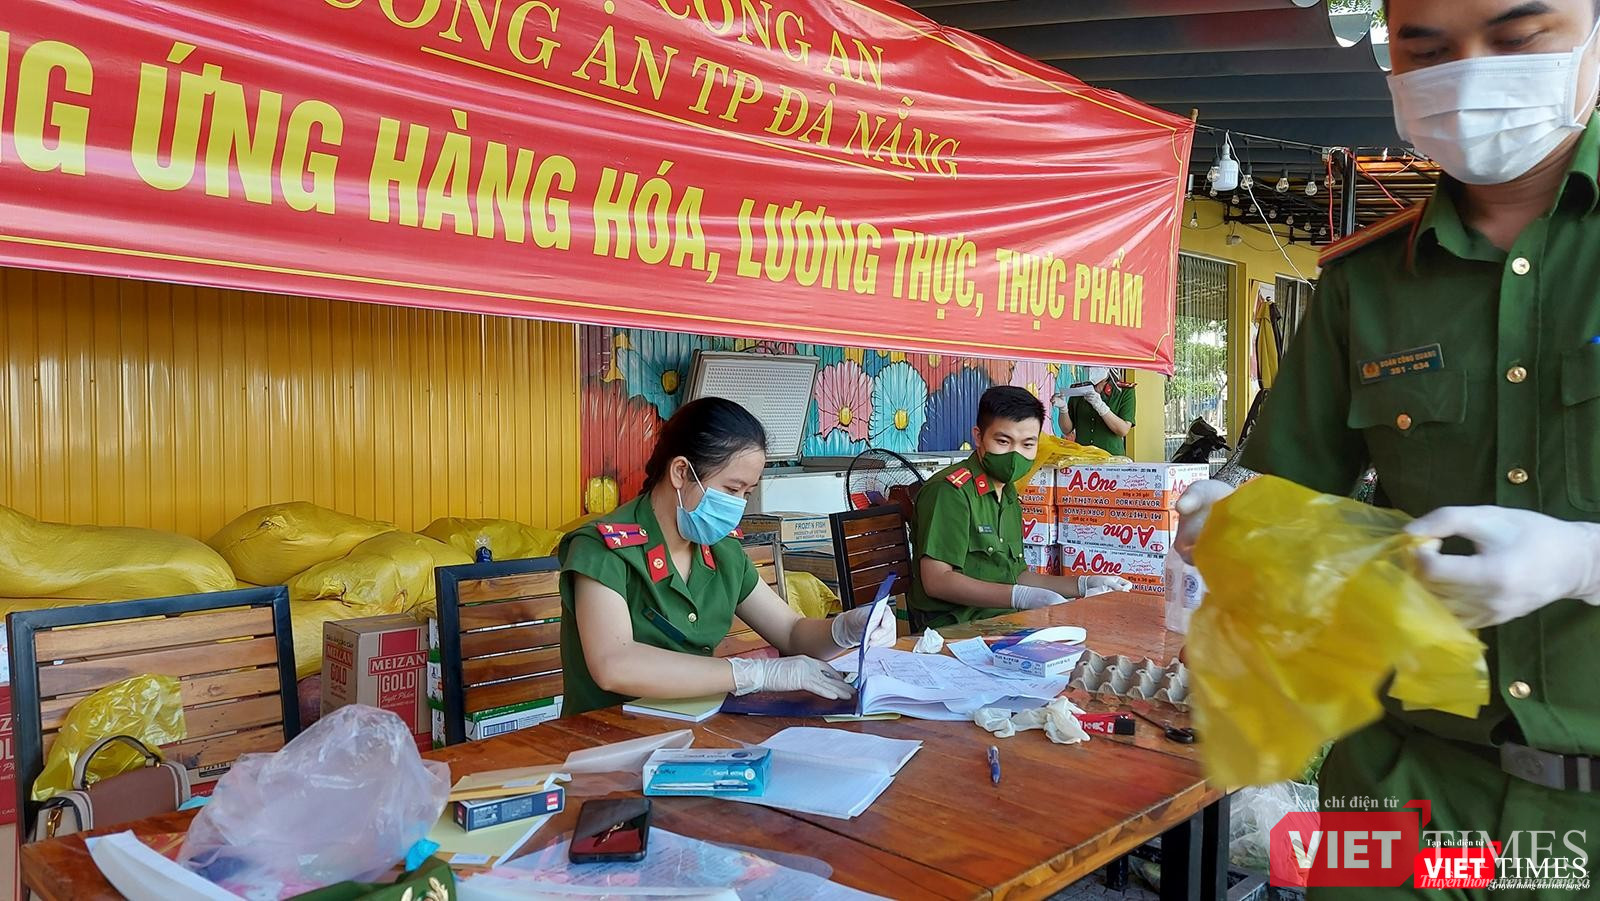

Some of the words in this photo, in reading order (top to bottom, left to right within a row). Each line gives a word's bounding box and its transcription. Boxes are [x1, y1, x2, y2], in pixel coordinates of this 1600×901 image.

[824, 30, 885, 91] AN
[322, 0, 561, 69] NG
[688, 56, 764, 124] TP
[764, 83, 838, 148] ĐÀ
[843, 96, 961, 181] NẴNG
[0, 31, 94, 176] G
[131, 44, 344, 215] ỨNG
[369, 109, 577, 251] HÀNG
[593, 161, 721, 285] HÓA,
[736, 198, 882, 295] LƯƠNG
[893, 226, 984, 321] THỰC,
[996, 248, 1066, 331] THỰC
[1073, 248, 1144, 329] PHẨM
[1068, 469, 1118, 491] A-One
[1087, 508, 1104, 516] PORK
[1115, 498, 1134, 506] PORK
[1135, 499, 1161, 507] FLAVOR
[1103, 524, 1155, 548] A-One
[1072, 551, 1122, 574] A-One
[371, 653, 426, 672] MEIZAN
[382, 671, 415, 693] GOLD
